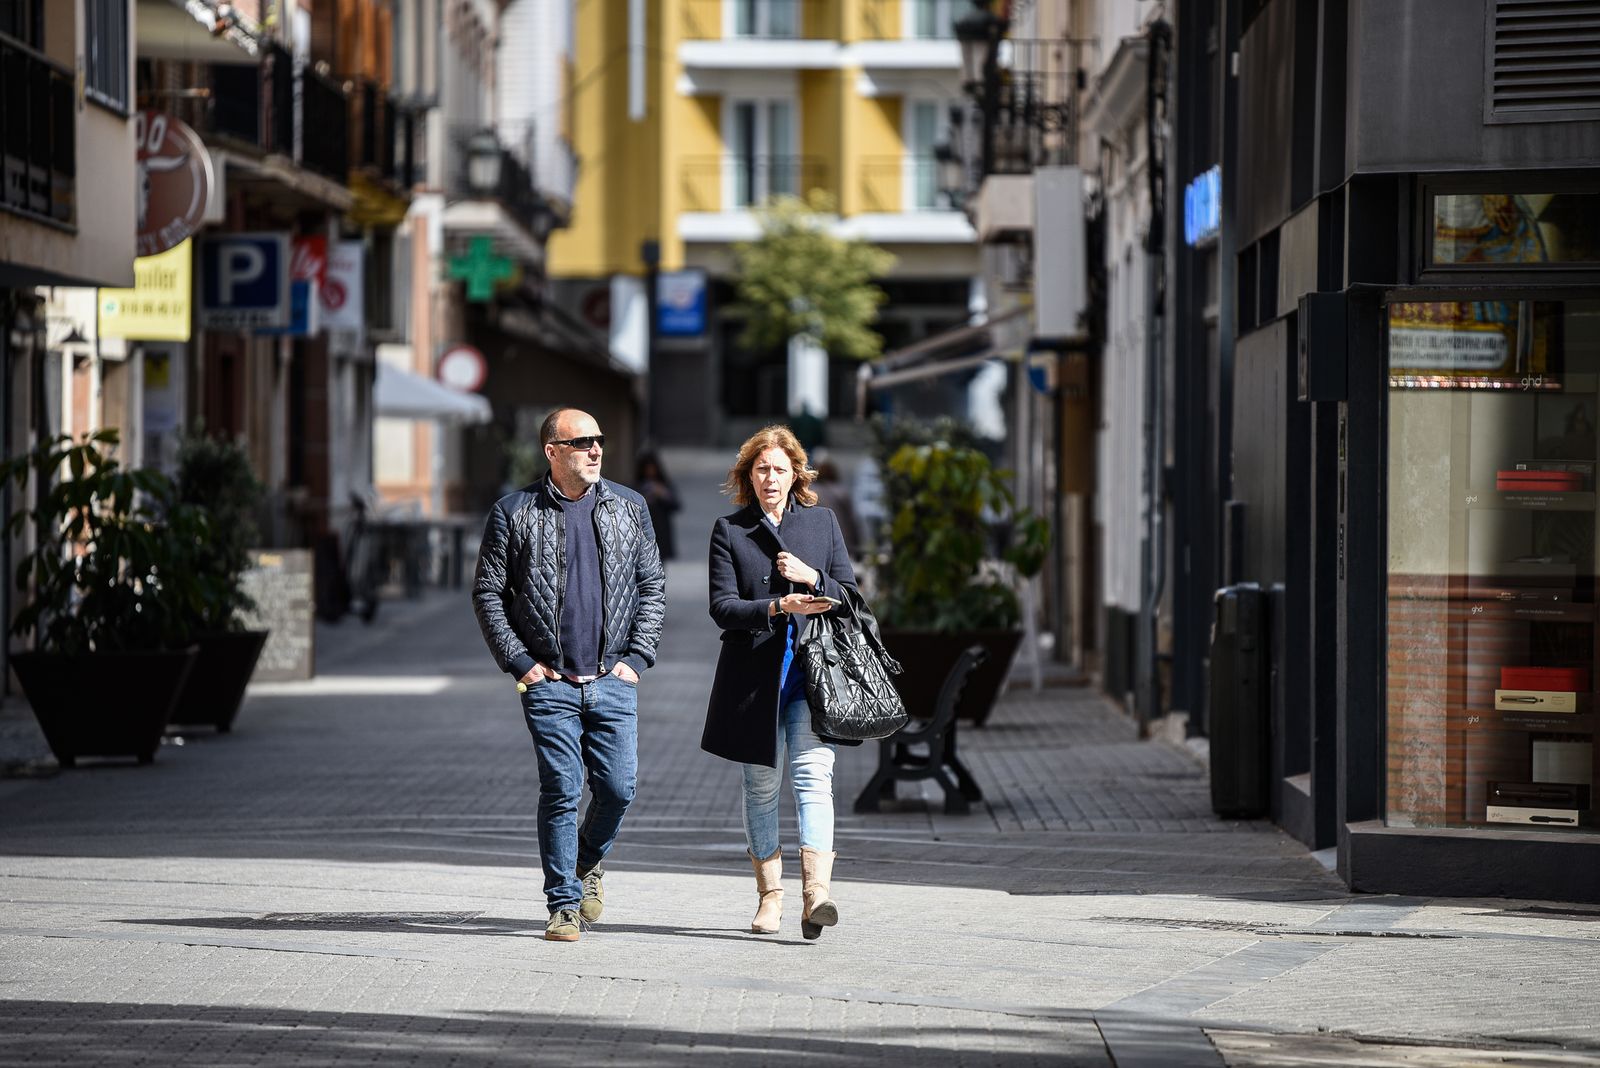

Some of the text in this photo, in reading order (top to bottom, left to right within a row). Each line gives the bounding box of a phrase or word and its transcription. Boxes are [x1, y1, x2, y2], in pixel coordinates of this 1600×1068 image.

[217, 244, 266, 304] P
[1521, 374, 1542, 391] ghd
[1466, 495, 1477, 505] ghd
[1472, 605, 1482, 615] ghd
[1468, 715, 1479, 725] ghd
